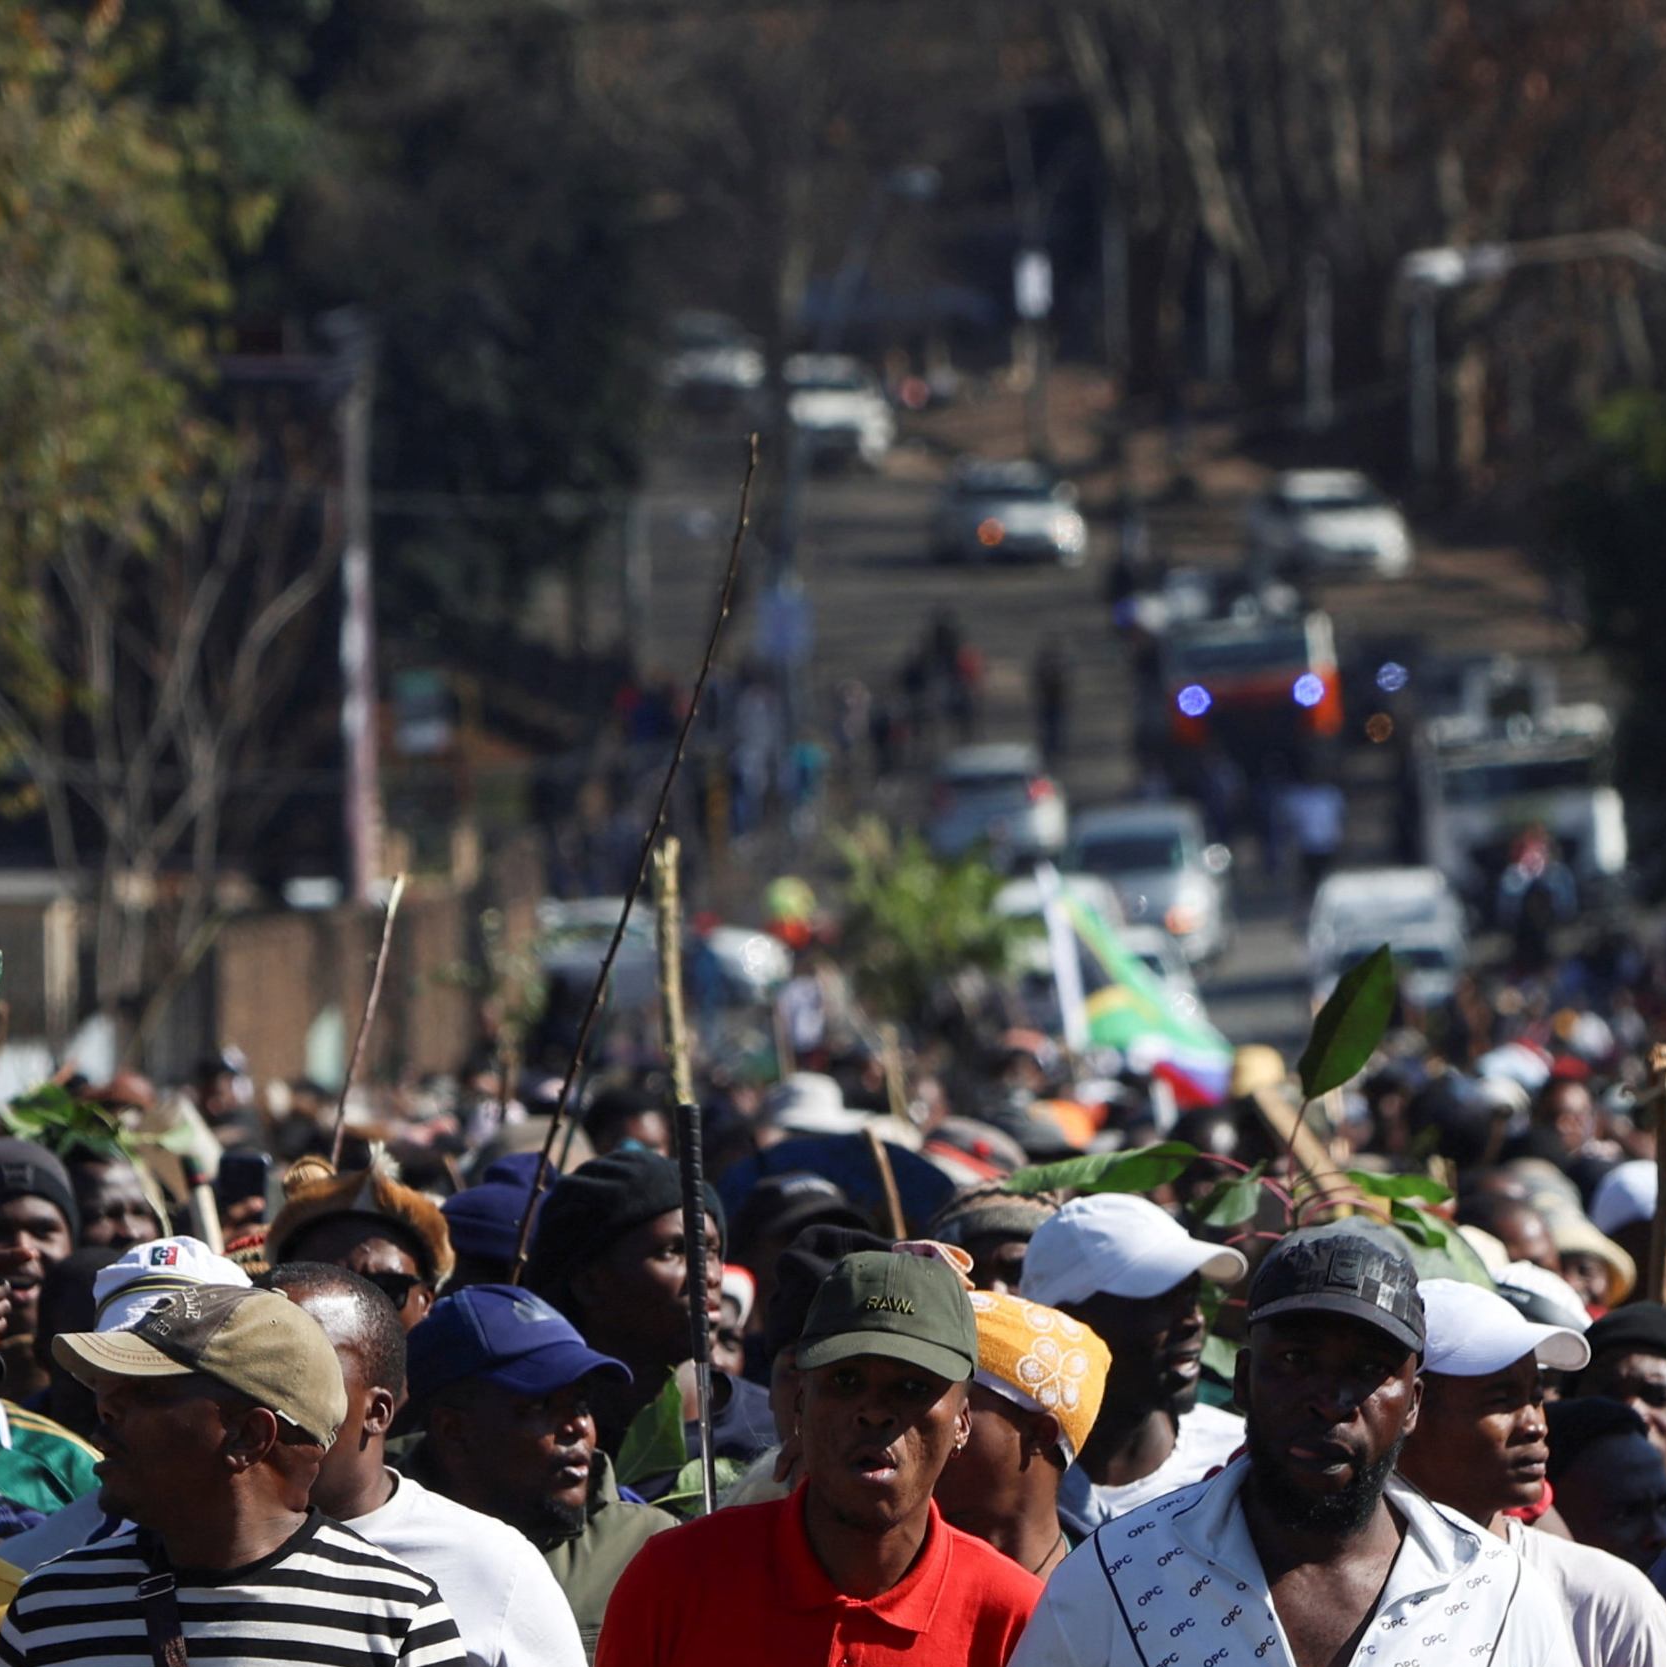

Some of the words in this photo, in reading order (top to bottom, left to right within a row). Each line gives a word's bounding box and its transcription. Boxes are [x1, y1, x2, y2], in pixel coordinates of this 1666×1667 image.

[1127, 1521, 1156, 1539] OPC
[1107, 1554, 1133, 1576] OPC
[1157, 1547, 1185, 1567] OPC
[1189, 1575, 1212, 1598] OPC
[1466, 1574, 1491, 1590] OPC
[1137, 1585, 1164, 1607] OPC
[1221, 1605, 1243, 1628] OPC
[1444, 1601, 1470, 1617] OPC
[1170, 1617, 1196, 1638] OPC
[1381, 1617, 1409, 1631] OPC
[1254, 1635, 1276, 1659] OPC
[1422, 1633, 1448, 1647] OPC
[1469, 1642, 1493, 1658] OPC
